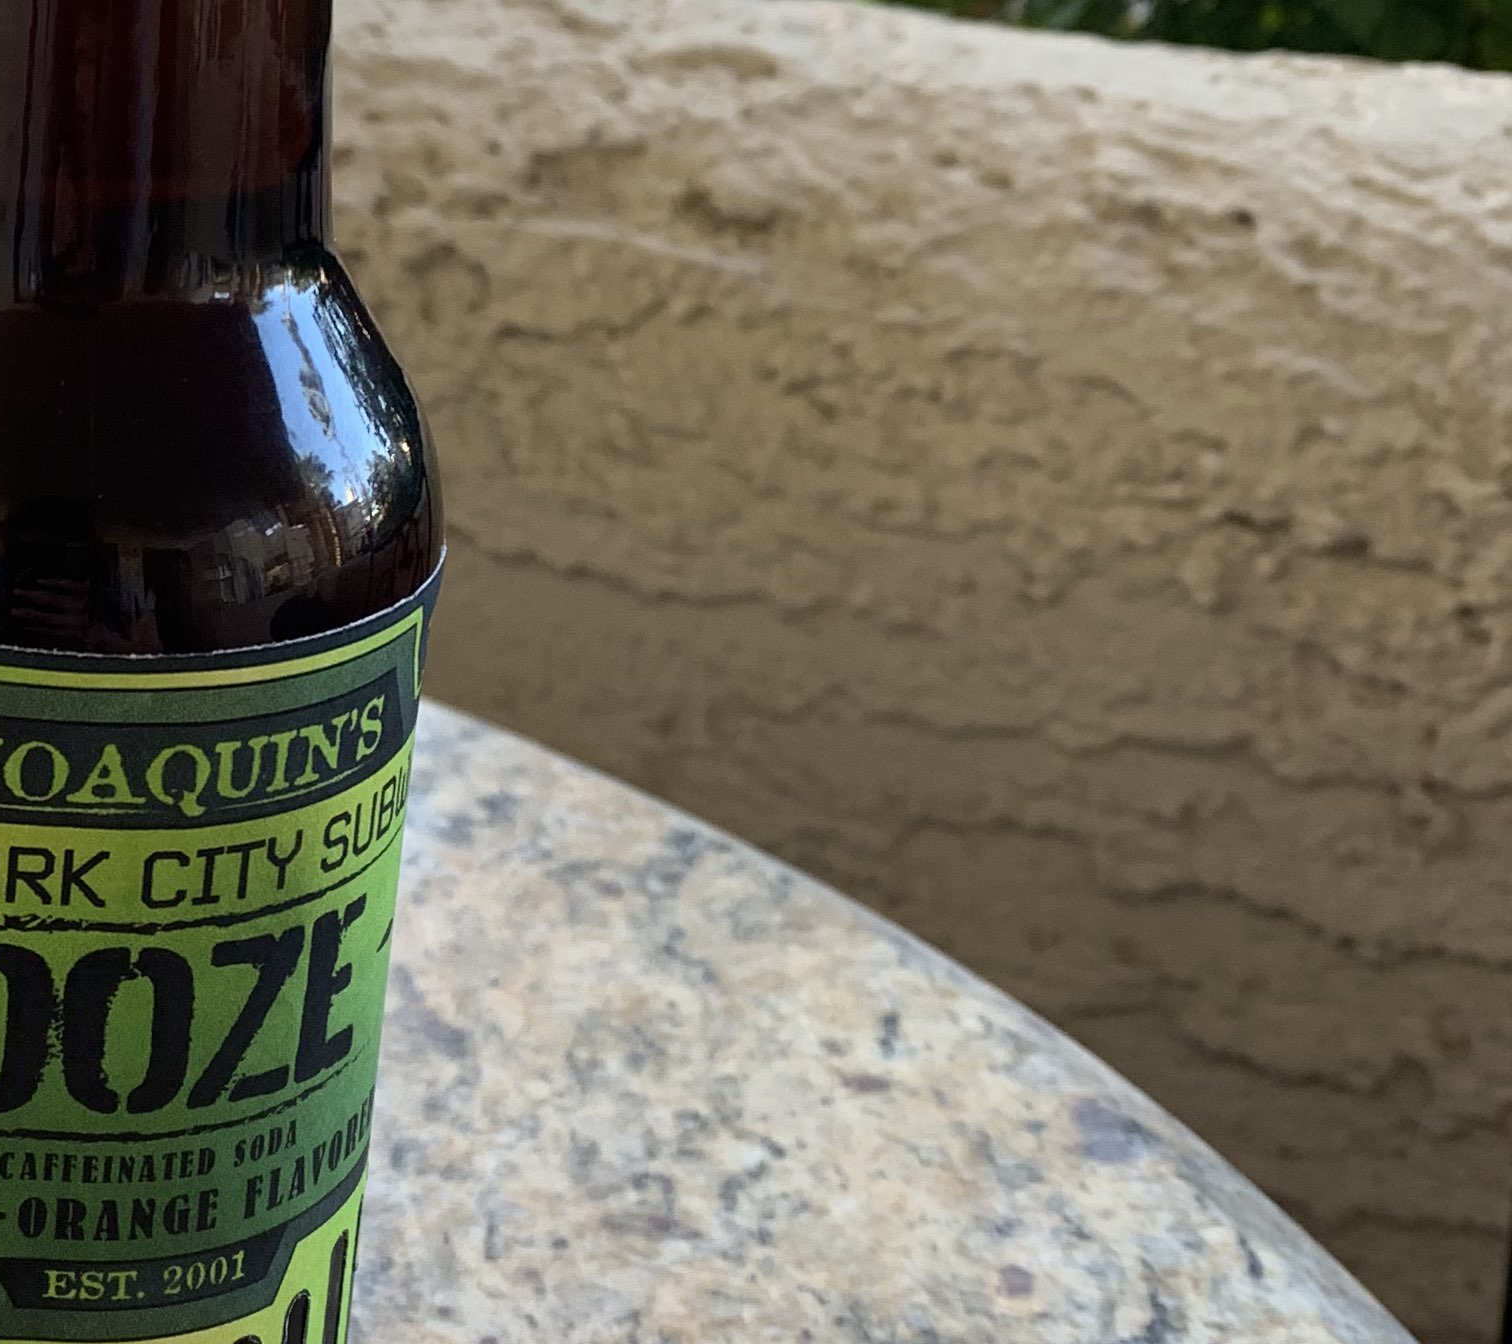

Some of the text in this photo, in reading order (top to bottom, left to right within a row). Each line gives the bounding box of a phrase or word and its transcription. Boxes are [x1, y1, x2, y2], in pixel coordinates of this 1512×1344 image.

[141, 829, 302, 909] CITY
[233, 1119, 297, 1168] SODA
[42, 1251, 246, 1301] EST. 2001
